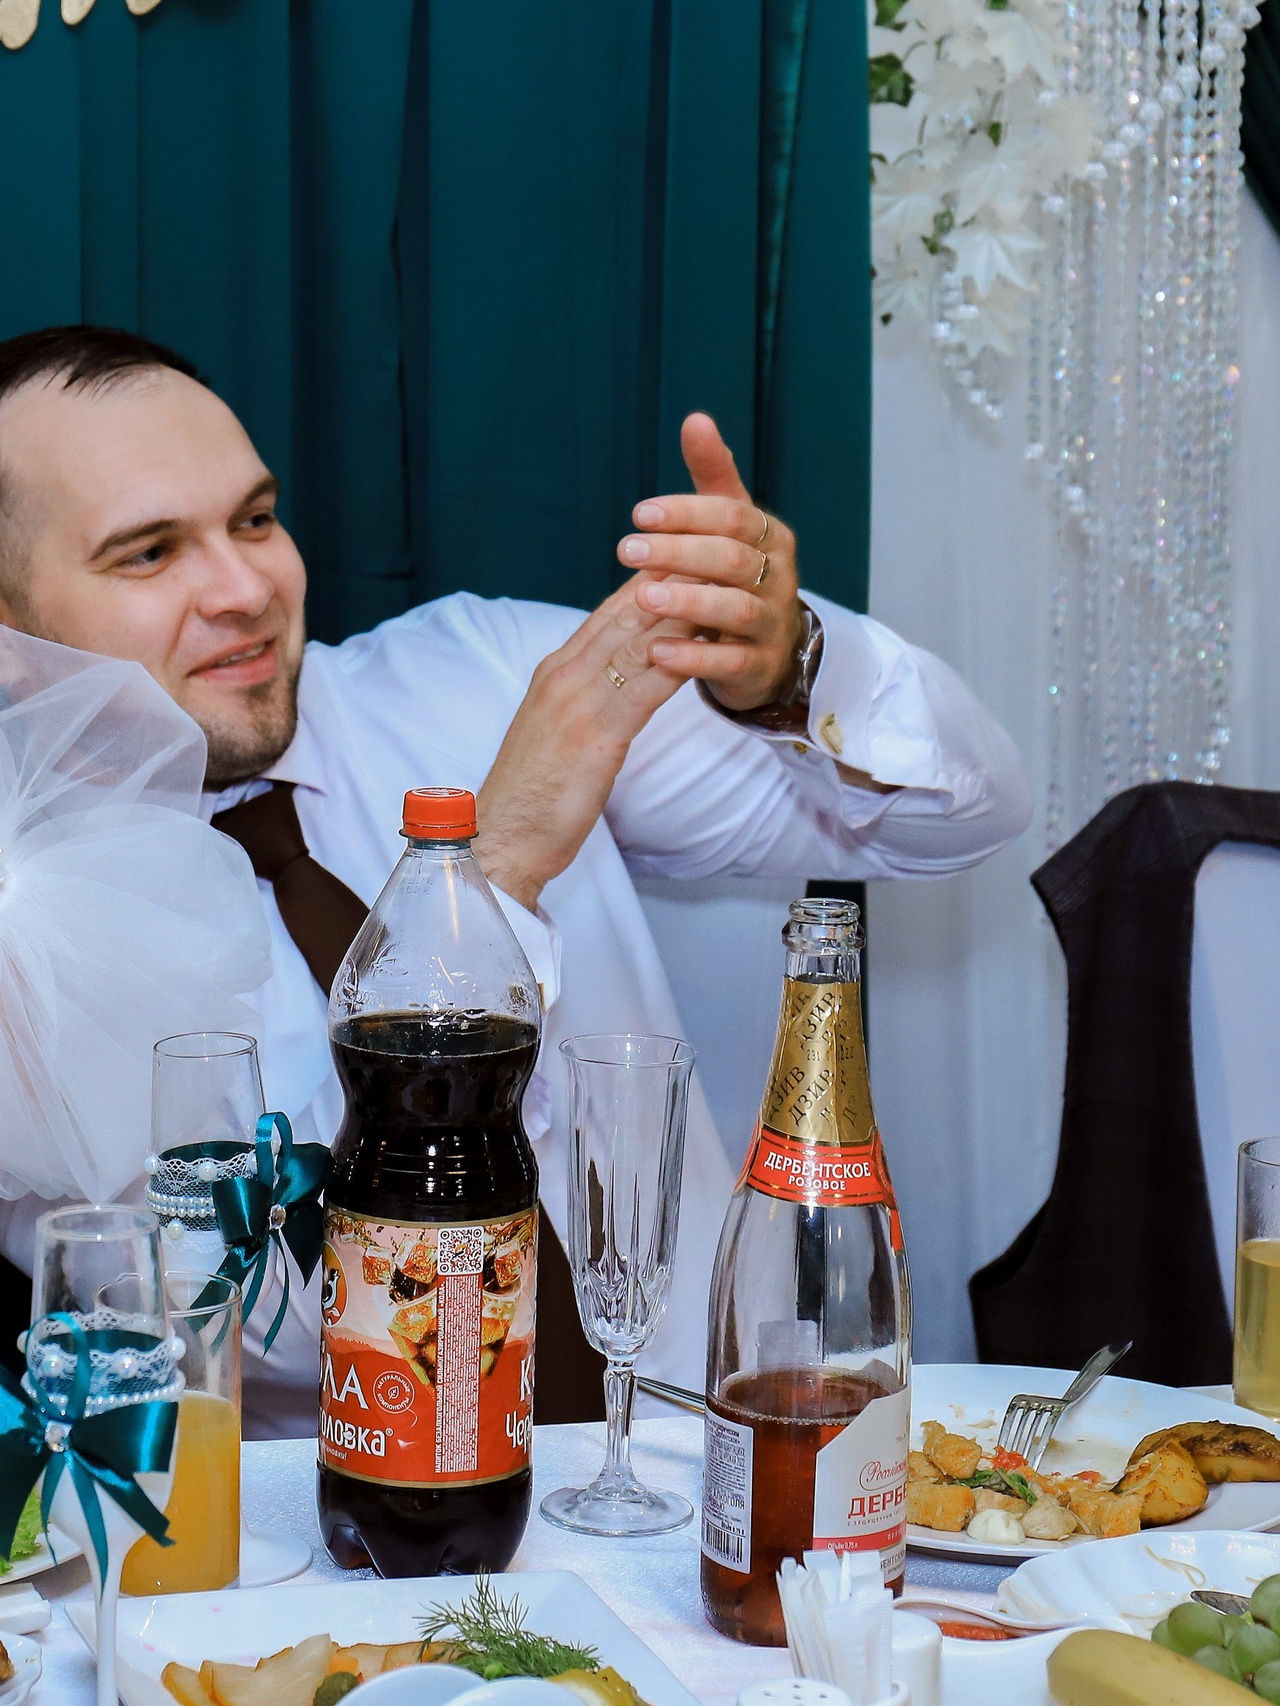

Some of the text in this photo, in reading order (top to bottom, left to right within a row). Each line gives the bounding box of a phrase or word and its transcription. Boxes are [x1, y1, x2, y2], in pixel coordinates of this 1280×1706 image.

[788, 1069, 834, 1126] ДЗИВ
[763, 1152, 872, 1179] ДЕРБЕНТСКОЕ
[788, 1175, 847, 1191] РОЗОВОЕ
[436, 1308, 445, 1384] СИЛЬНОГАЗИРОВАННЫЙ
[319, 1351, 370, 1410] ЛА
[377, 1374, 412, 1393] НАТУРАЛЬНЫЕ
[377, 1393, 411, 1411] КОМПОНЕНТЫ
[519, 1353, 535, 1402] К
[435, 1384, 443, 1443] БЕЗАЛКОГОЛЬНЫЙ
